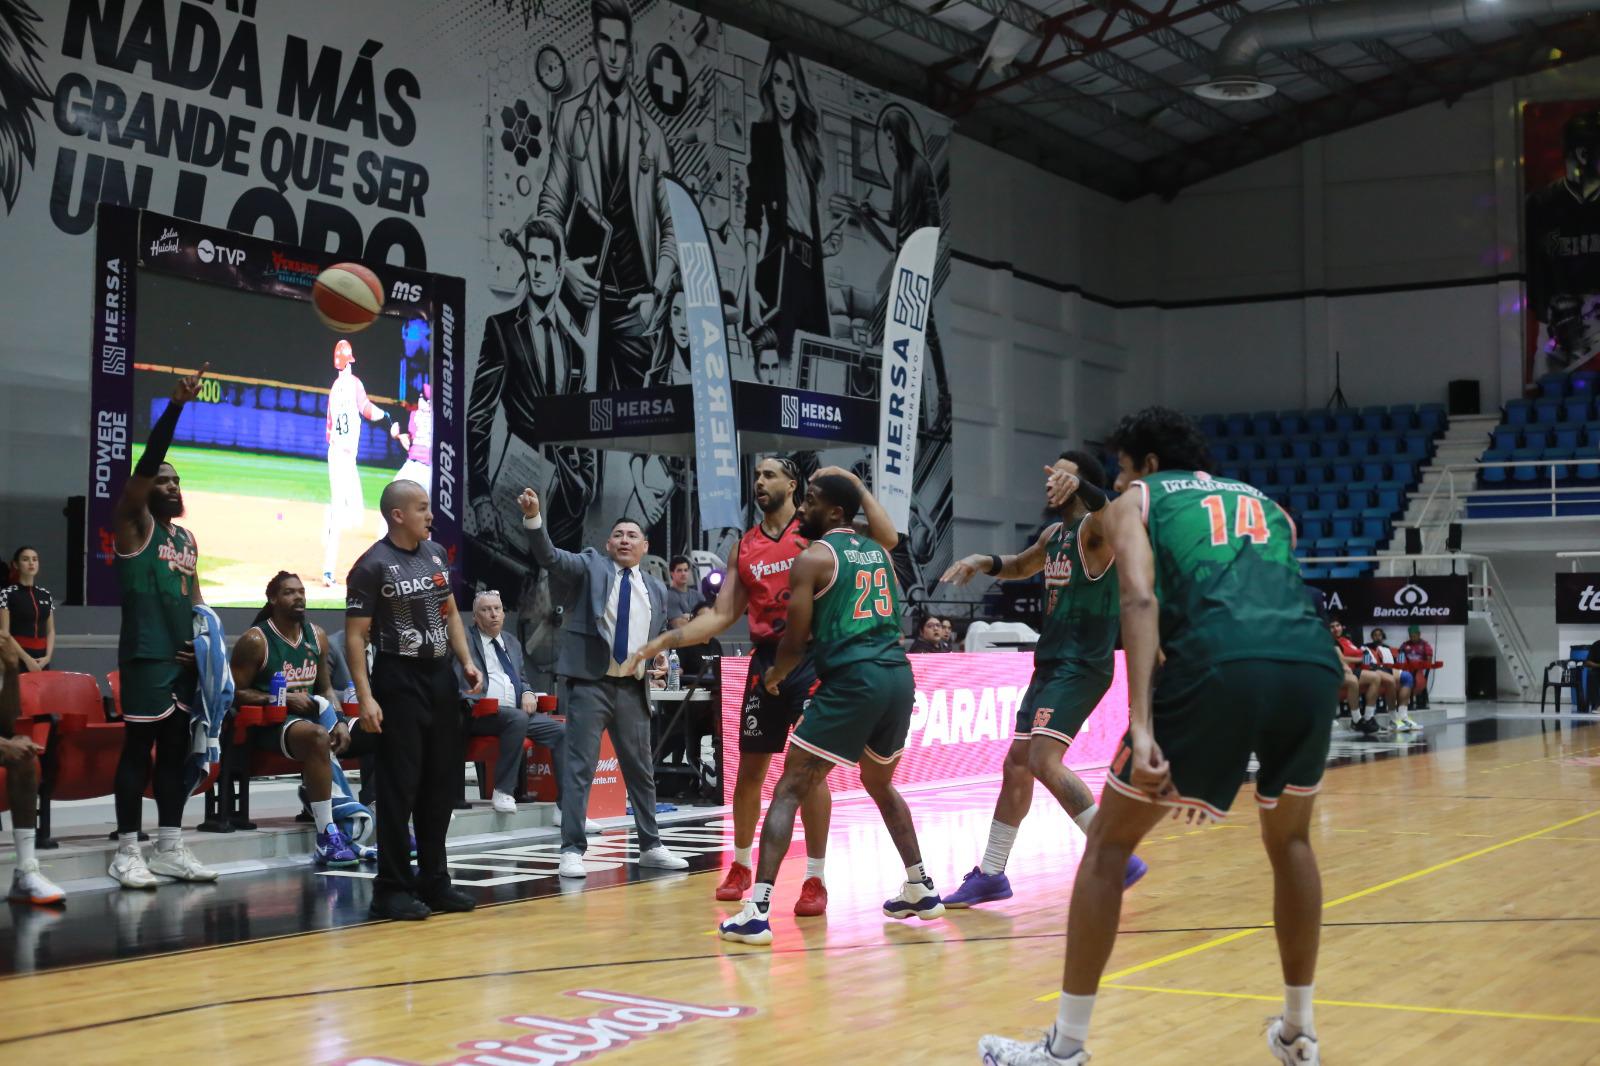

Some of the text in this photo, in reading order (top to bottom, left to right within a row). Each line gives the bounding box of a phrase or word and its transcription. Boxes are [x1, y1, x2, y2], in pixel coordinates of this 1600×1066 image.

[61, 0, 421, 147] NADA MÁS
[53, 72, 429, 217] GRANDE QUE SER
[151, 238, 181, 256] Huichol
[215, 246, 246, 265] TVP
[105, 258, 120, 342] HERSA
[442, 303, 455, 421] dportenis
[335, 412, 349, 435] 43
[617, 399, 675, 417] HERSA
[801, 402, 842, 422] HERSA
[886, 338, 910, 475] HERSA
[905, 354, 919, 462] CORPORATIVO
[96, 411, 112, 498] POWER
[112, 412, 127, 460] ADE
[440, 441, 455, 521] telcel
[1201, 494, 1270, 546] 14
[853, 567, 892, 619] 23
[1373, 605, 1450, 617] Banco Azteca
[285, 659, 317, 680] ochis
